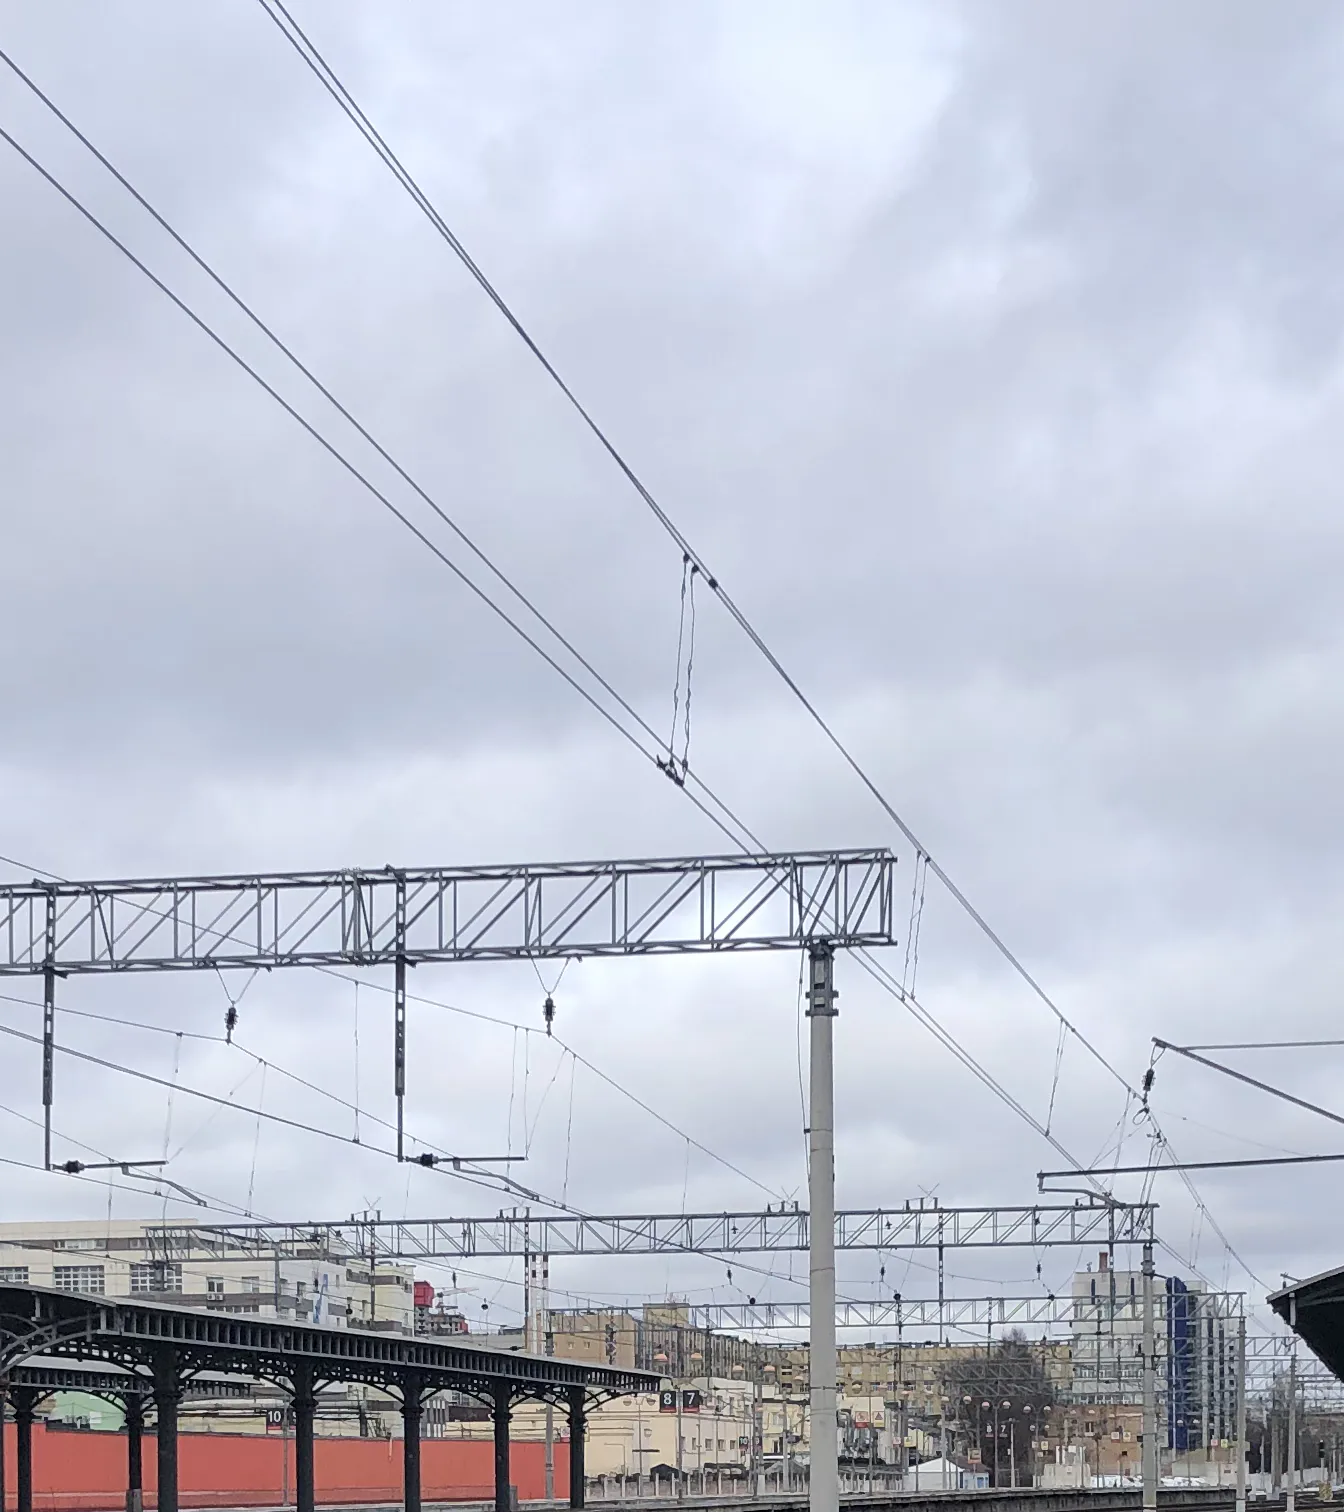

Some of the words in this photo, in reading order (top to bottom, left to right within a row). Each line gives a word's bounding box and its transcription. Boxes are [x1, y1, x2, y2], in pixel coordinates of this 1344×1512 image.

[663, 1392, 673, 1405] 8
[687, 1392, 696, 1405] 7
[267, 1410, 282, 1423] 10
[1000, 1424, 1007, 1433] 7
